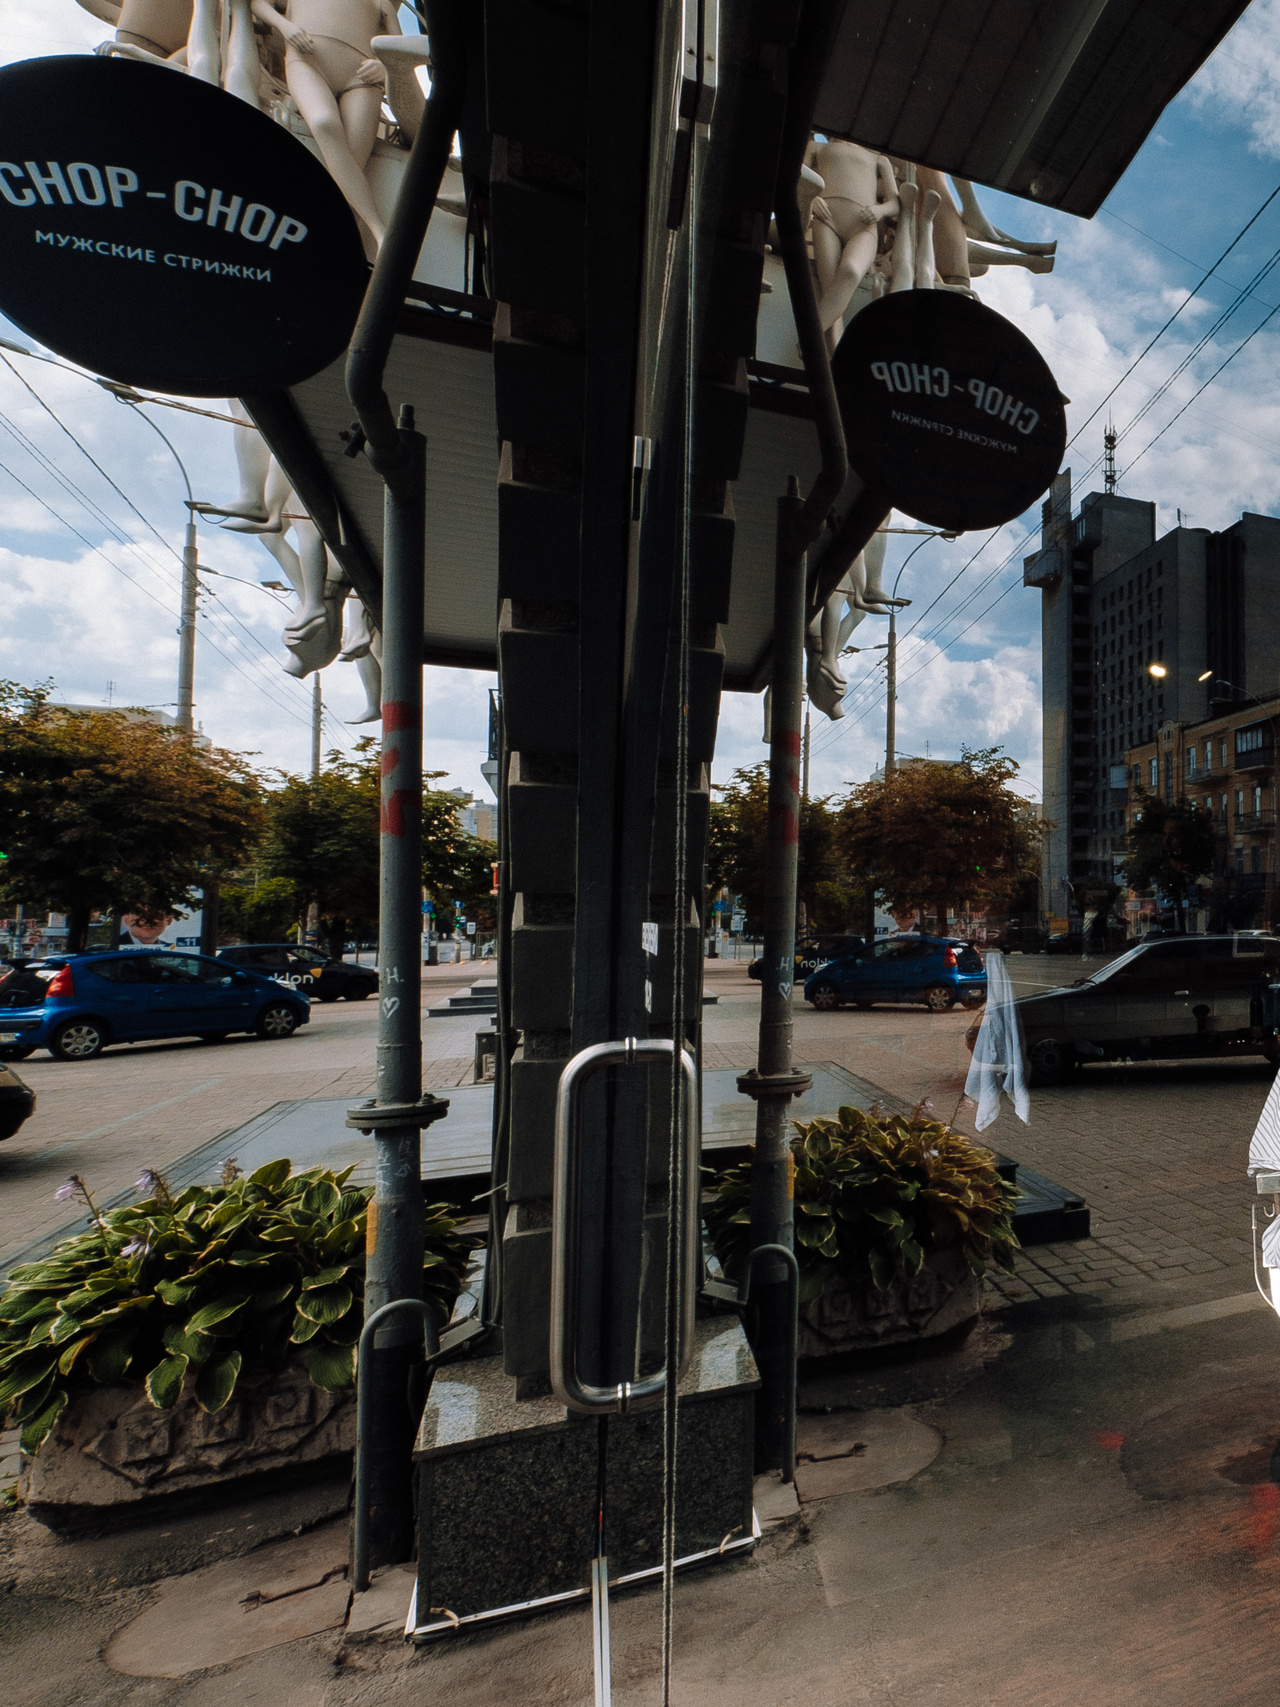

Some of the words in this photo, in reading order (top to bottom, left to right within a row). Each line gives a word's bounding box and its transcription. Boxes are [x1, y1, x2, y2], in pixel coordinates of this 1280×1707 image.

[0, 161, 308, 250] CHOP-CHOP
[35, 230, 156, 263] МУЖСКИЕ
[163, 254, 271, 282] СТРИЖКИ
[268, 971, 314, 985] klon
